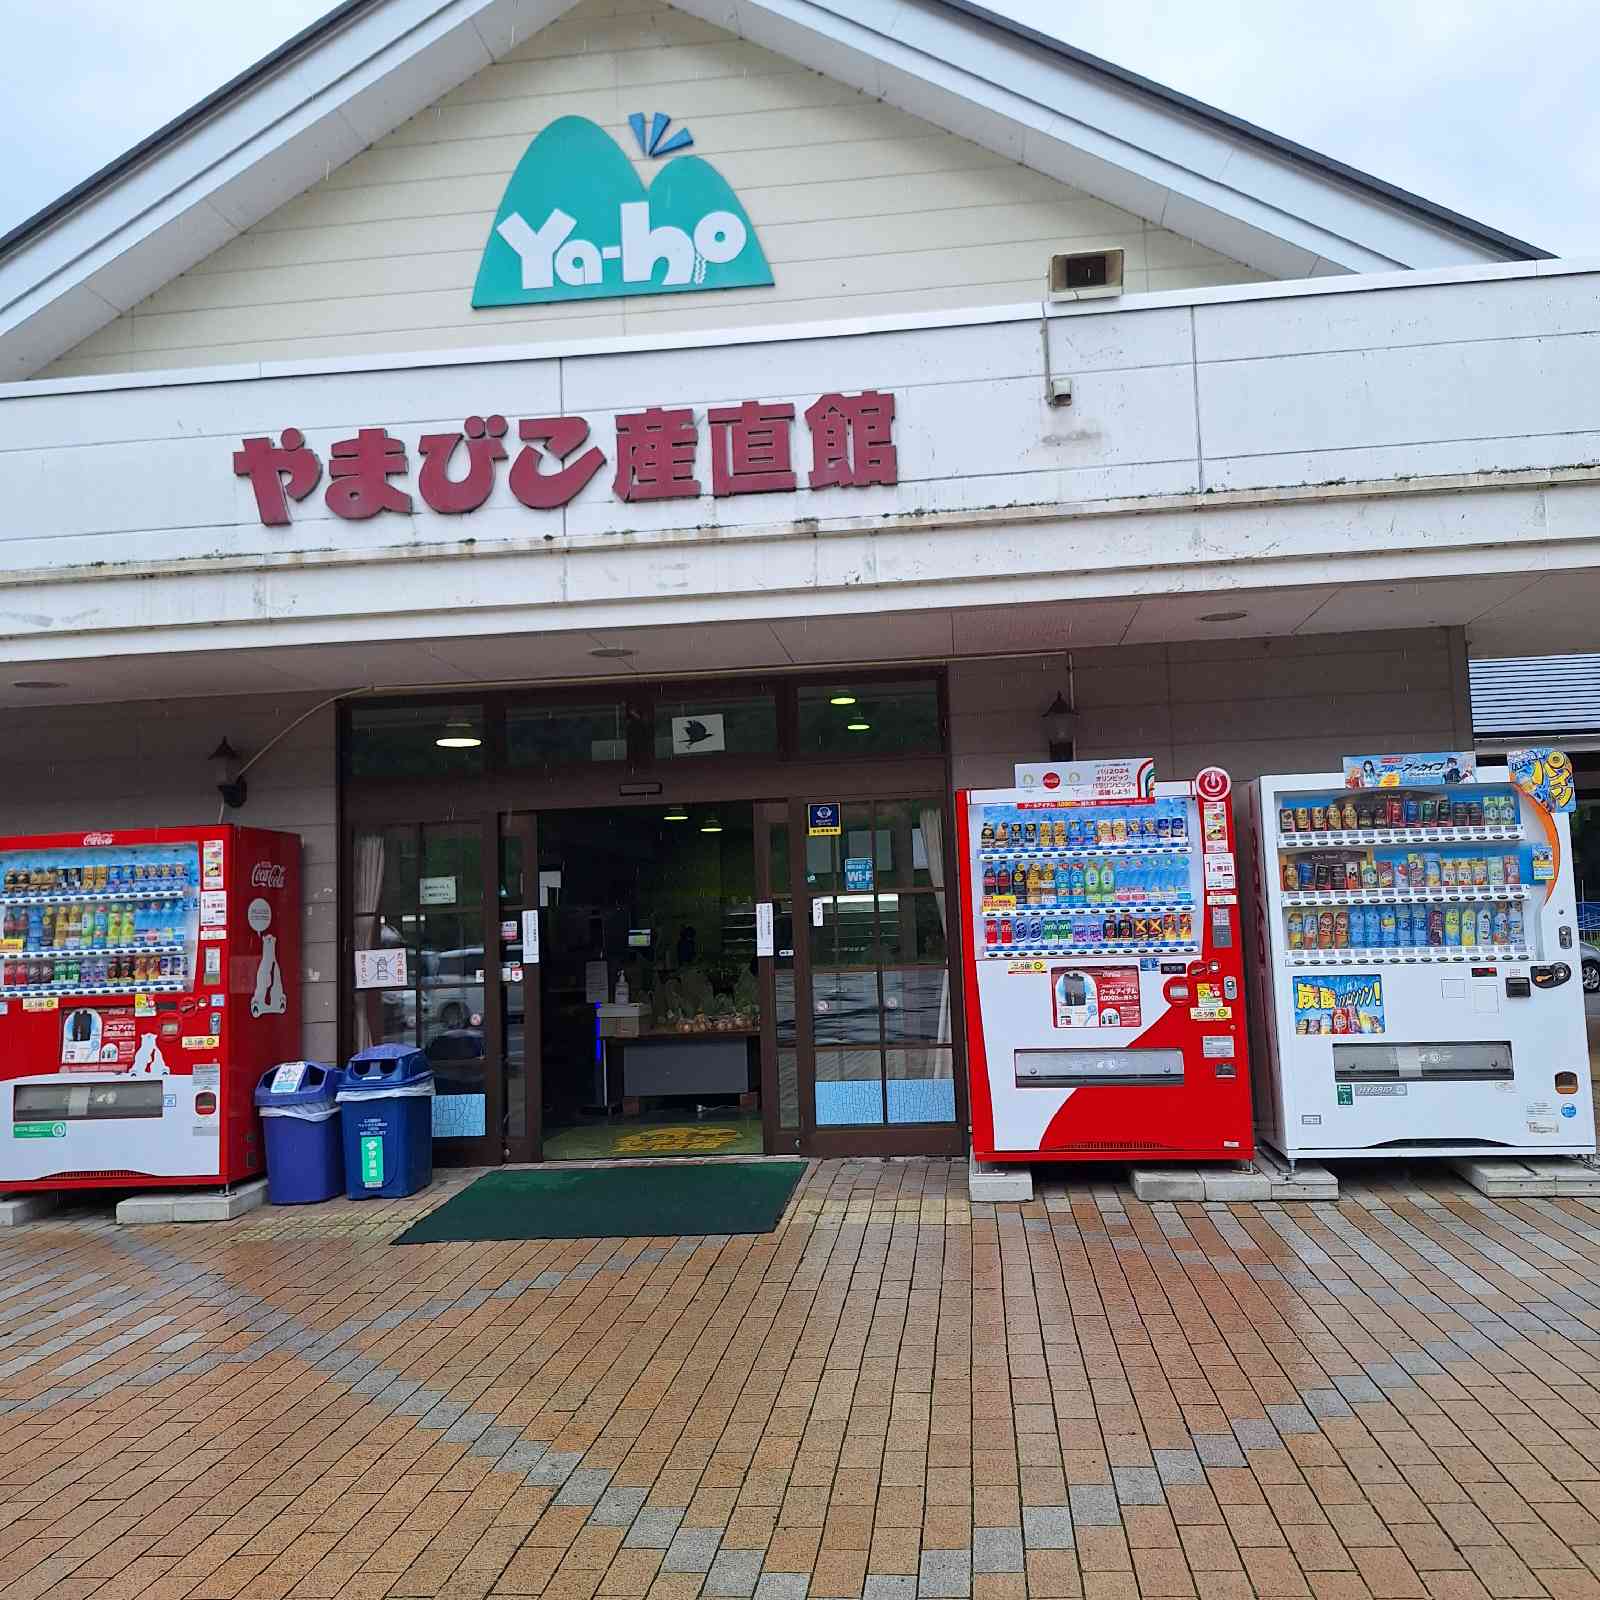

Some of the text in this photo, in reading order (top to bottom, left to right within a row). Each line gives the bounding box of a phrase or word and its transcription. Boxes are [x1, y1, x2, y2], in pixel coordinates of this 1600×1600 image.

[496, 200, 748, 290] Ya-ho
[233, 391, 899, 527] やまびこ産直館
[251, 863, 286, 888] Coca-Cola
[847, 870, 874, 882] Wi-F
